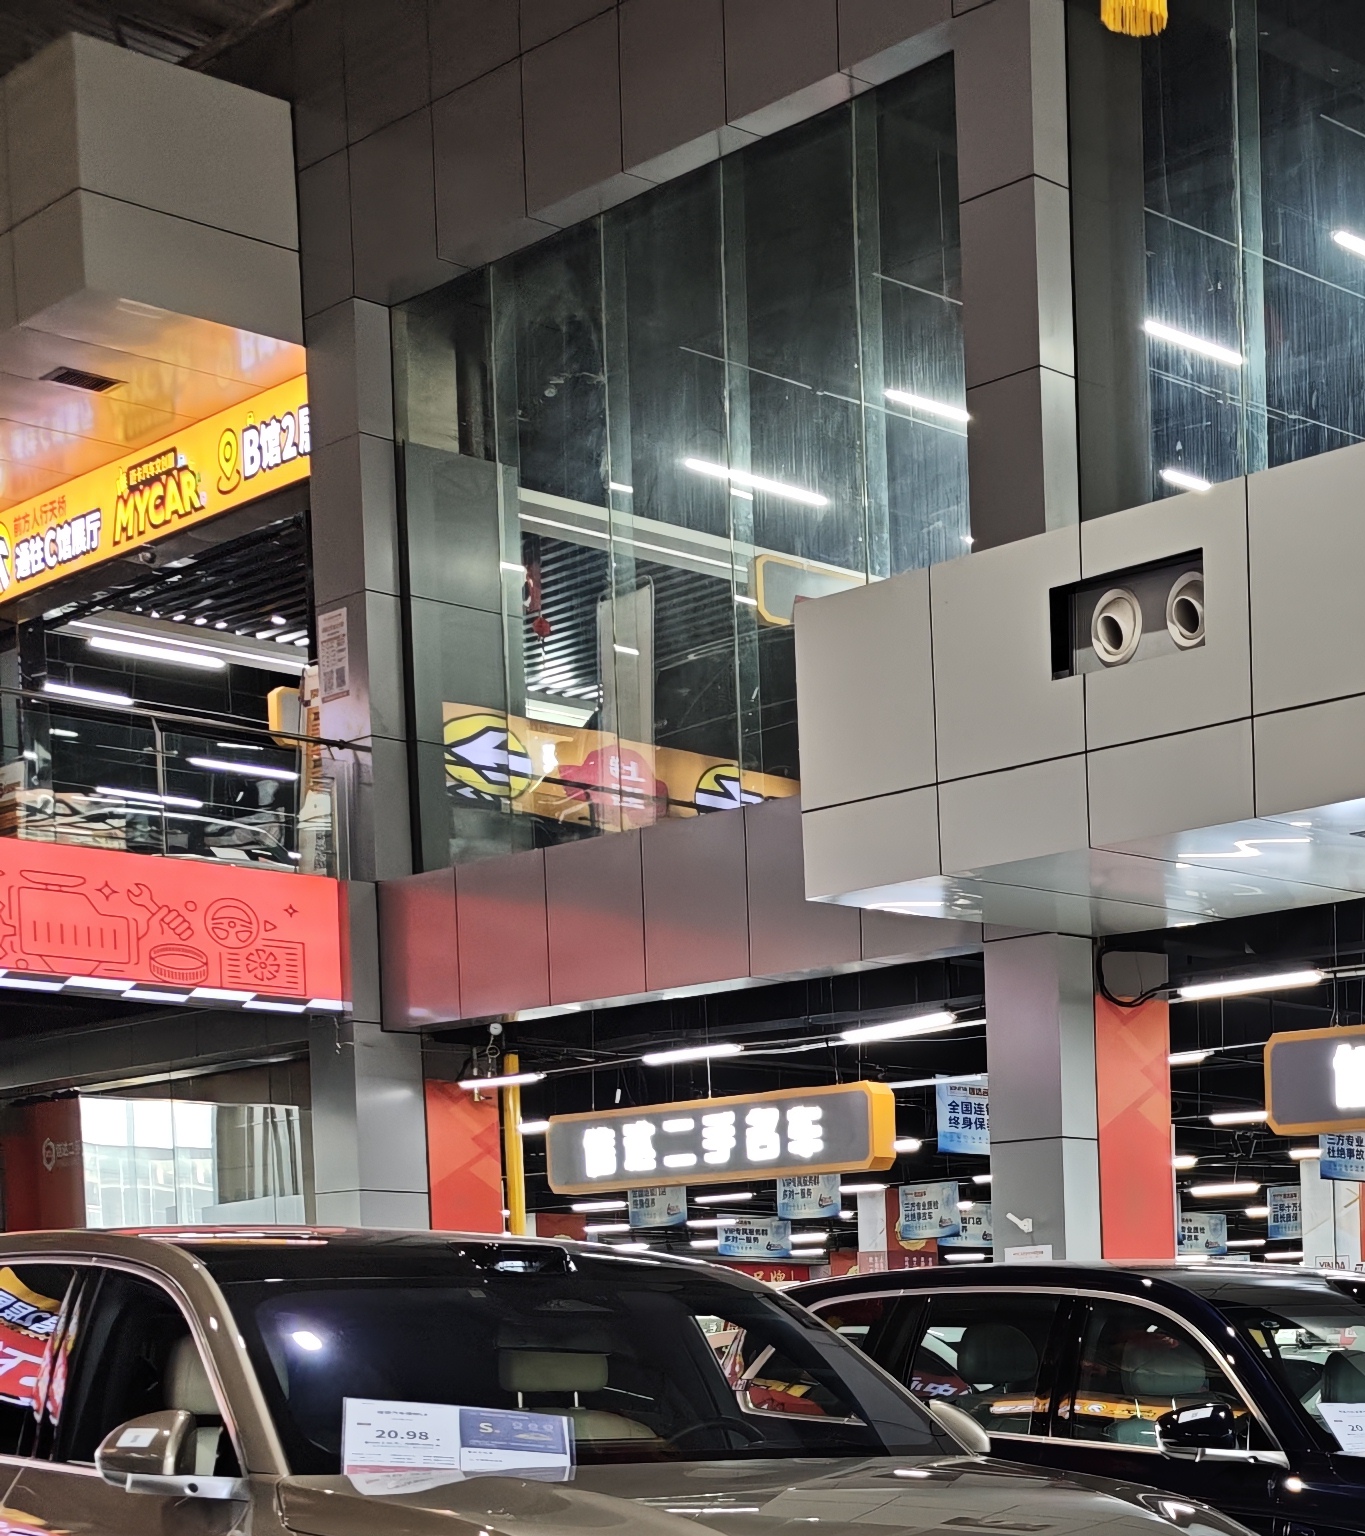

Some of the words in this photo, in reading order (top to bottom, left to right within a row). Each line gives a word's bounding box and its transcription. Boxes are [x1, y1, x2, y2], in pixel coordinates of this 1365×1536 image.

[13, 495, 67, 535] 前方人行天桥
[114, 468, 204, 546] MYCAR
[15, 509, 101, 582] 通往C馆展厅
[375, 1429, 430, 1441] 20.98
